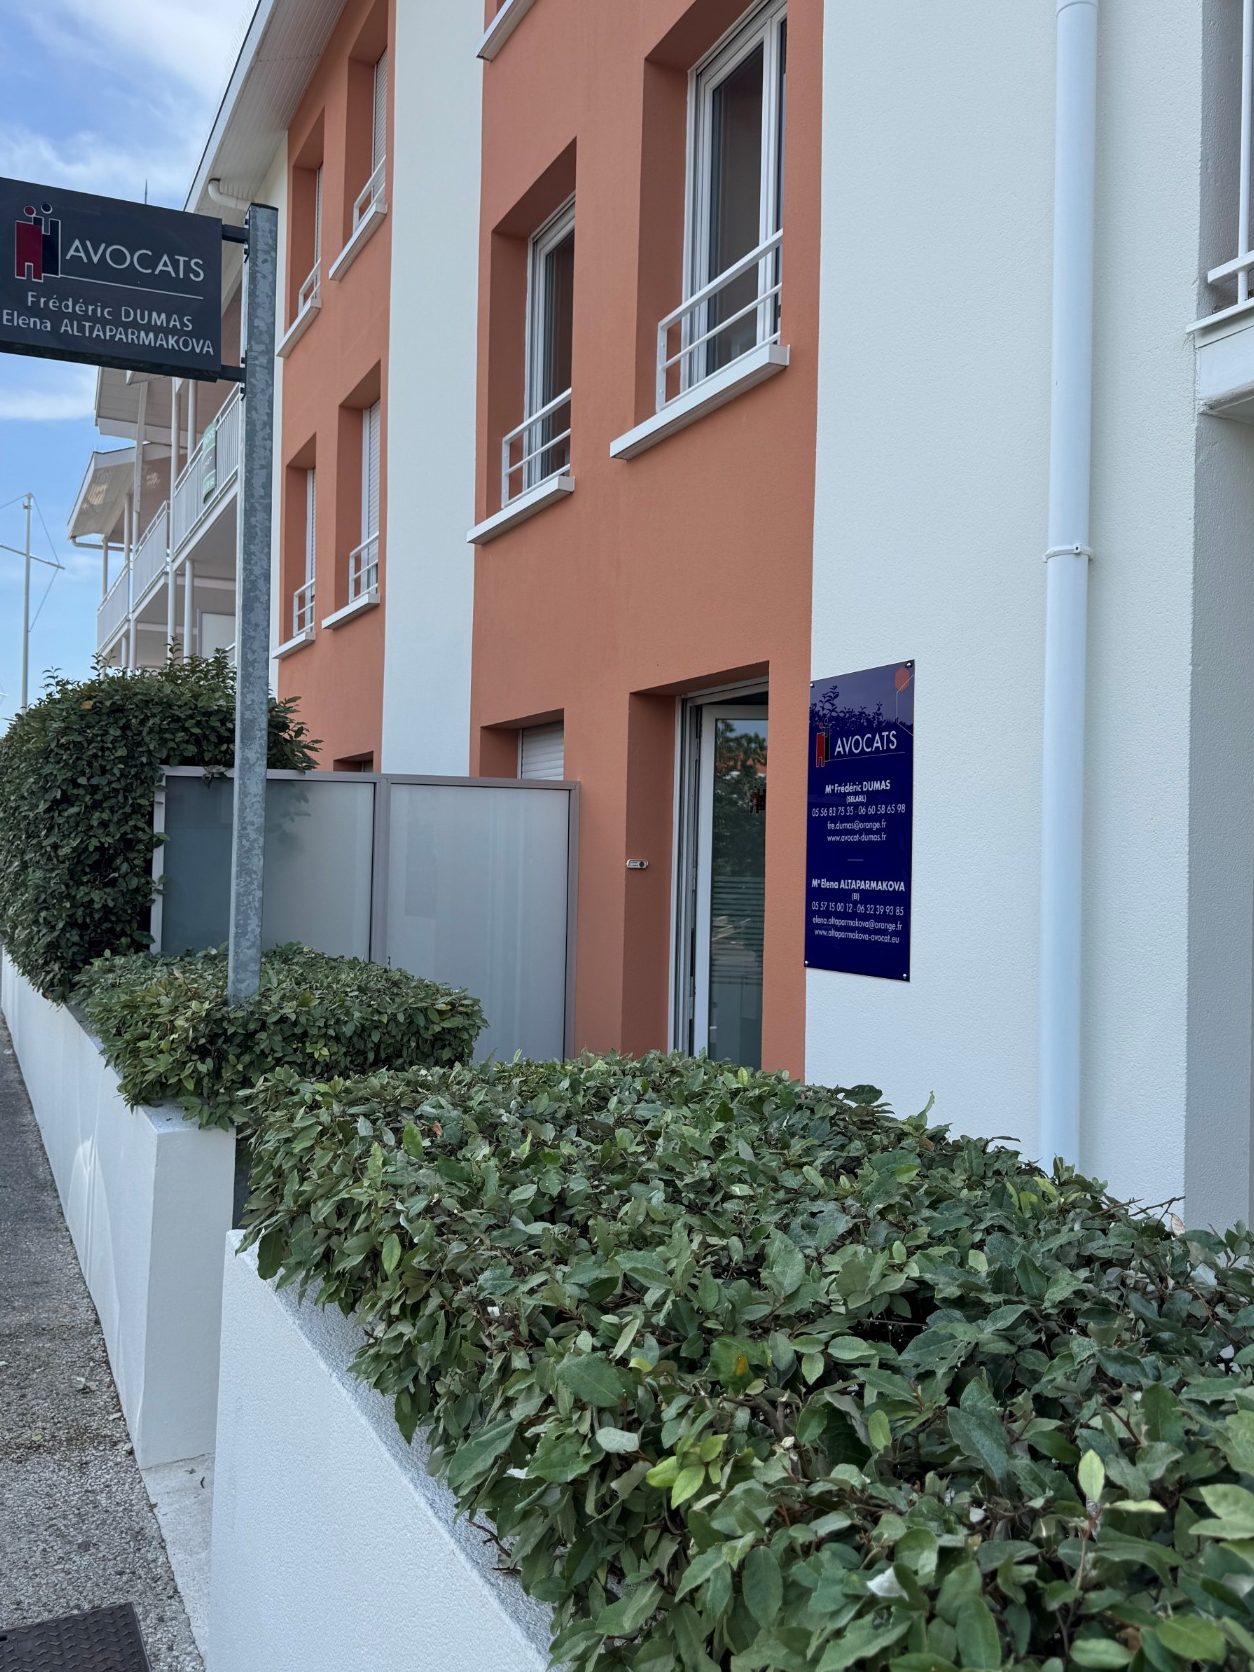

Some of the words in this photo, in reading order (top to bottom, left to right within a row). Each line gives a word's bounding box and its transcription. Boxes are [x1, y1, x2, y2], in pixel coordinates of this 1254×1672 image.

[66, 238, 204, 281] AVOCATS
[28, 292, 112, 319] Frédéric
[122, 307, 192, 330] DUMAS
[3, 310, 51, 331] Elena
[60, 319, 214, 355] ALTAPARMAKOVA
[835, 731, 897, 756] AVOCATS
[835, 782, 861, 793] Frédéric
[863, 780, 890, 791] DUMAS
[846, 795, 866, 804] (SELARL)
[812, 808, 818, 816] 05
[838, 807, 844, 815] 75
[846, 807, 853, 815] 35
[858, 806, 866, 814] 06
[868, 806, 875, 814] 60
[877, 805, 885, 814] 58
[887, 804, 895, 813] 65
[897, 804, 905, 813] 98
[827, 832, 886, 841] www.avocat-dumas.fr
[821, 878, 838, 888] Elena
[840, 880, 905, 891] ALTAPARMAKOVA
[820, 902, 827, 910] 57
[829, 902, 835, 911] 15
[837, 903, 844, 911] 00
[846, 904, 852, 912] 12
[857, 904, 864, 913] 06
[866, 905, 874, 914] 32
[876, 905, 884, 914] 39
[886, 906, 893, 915] 93
[896, 907, 904, 916] 85
[815, 928, 899, 943] www.altaparmakova-avocat.eu
